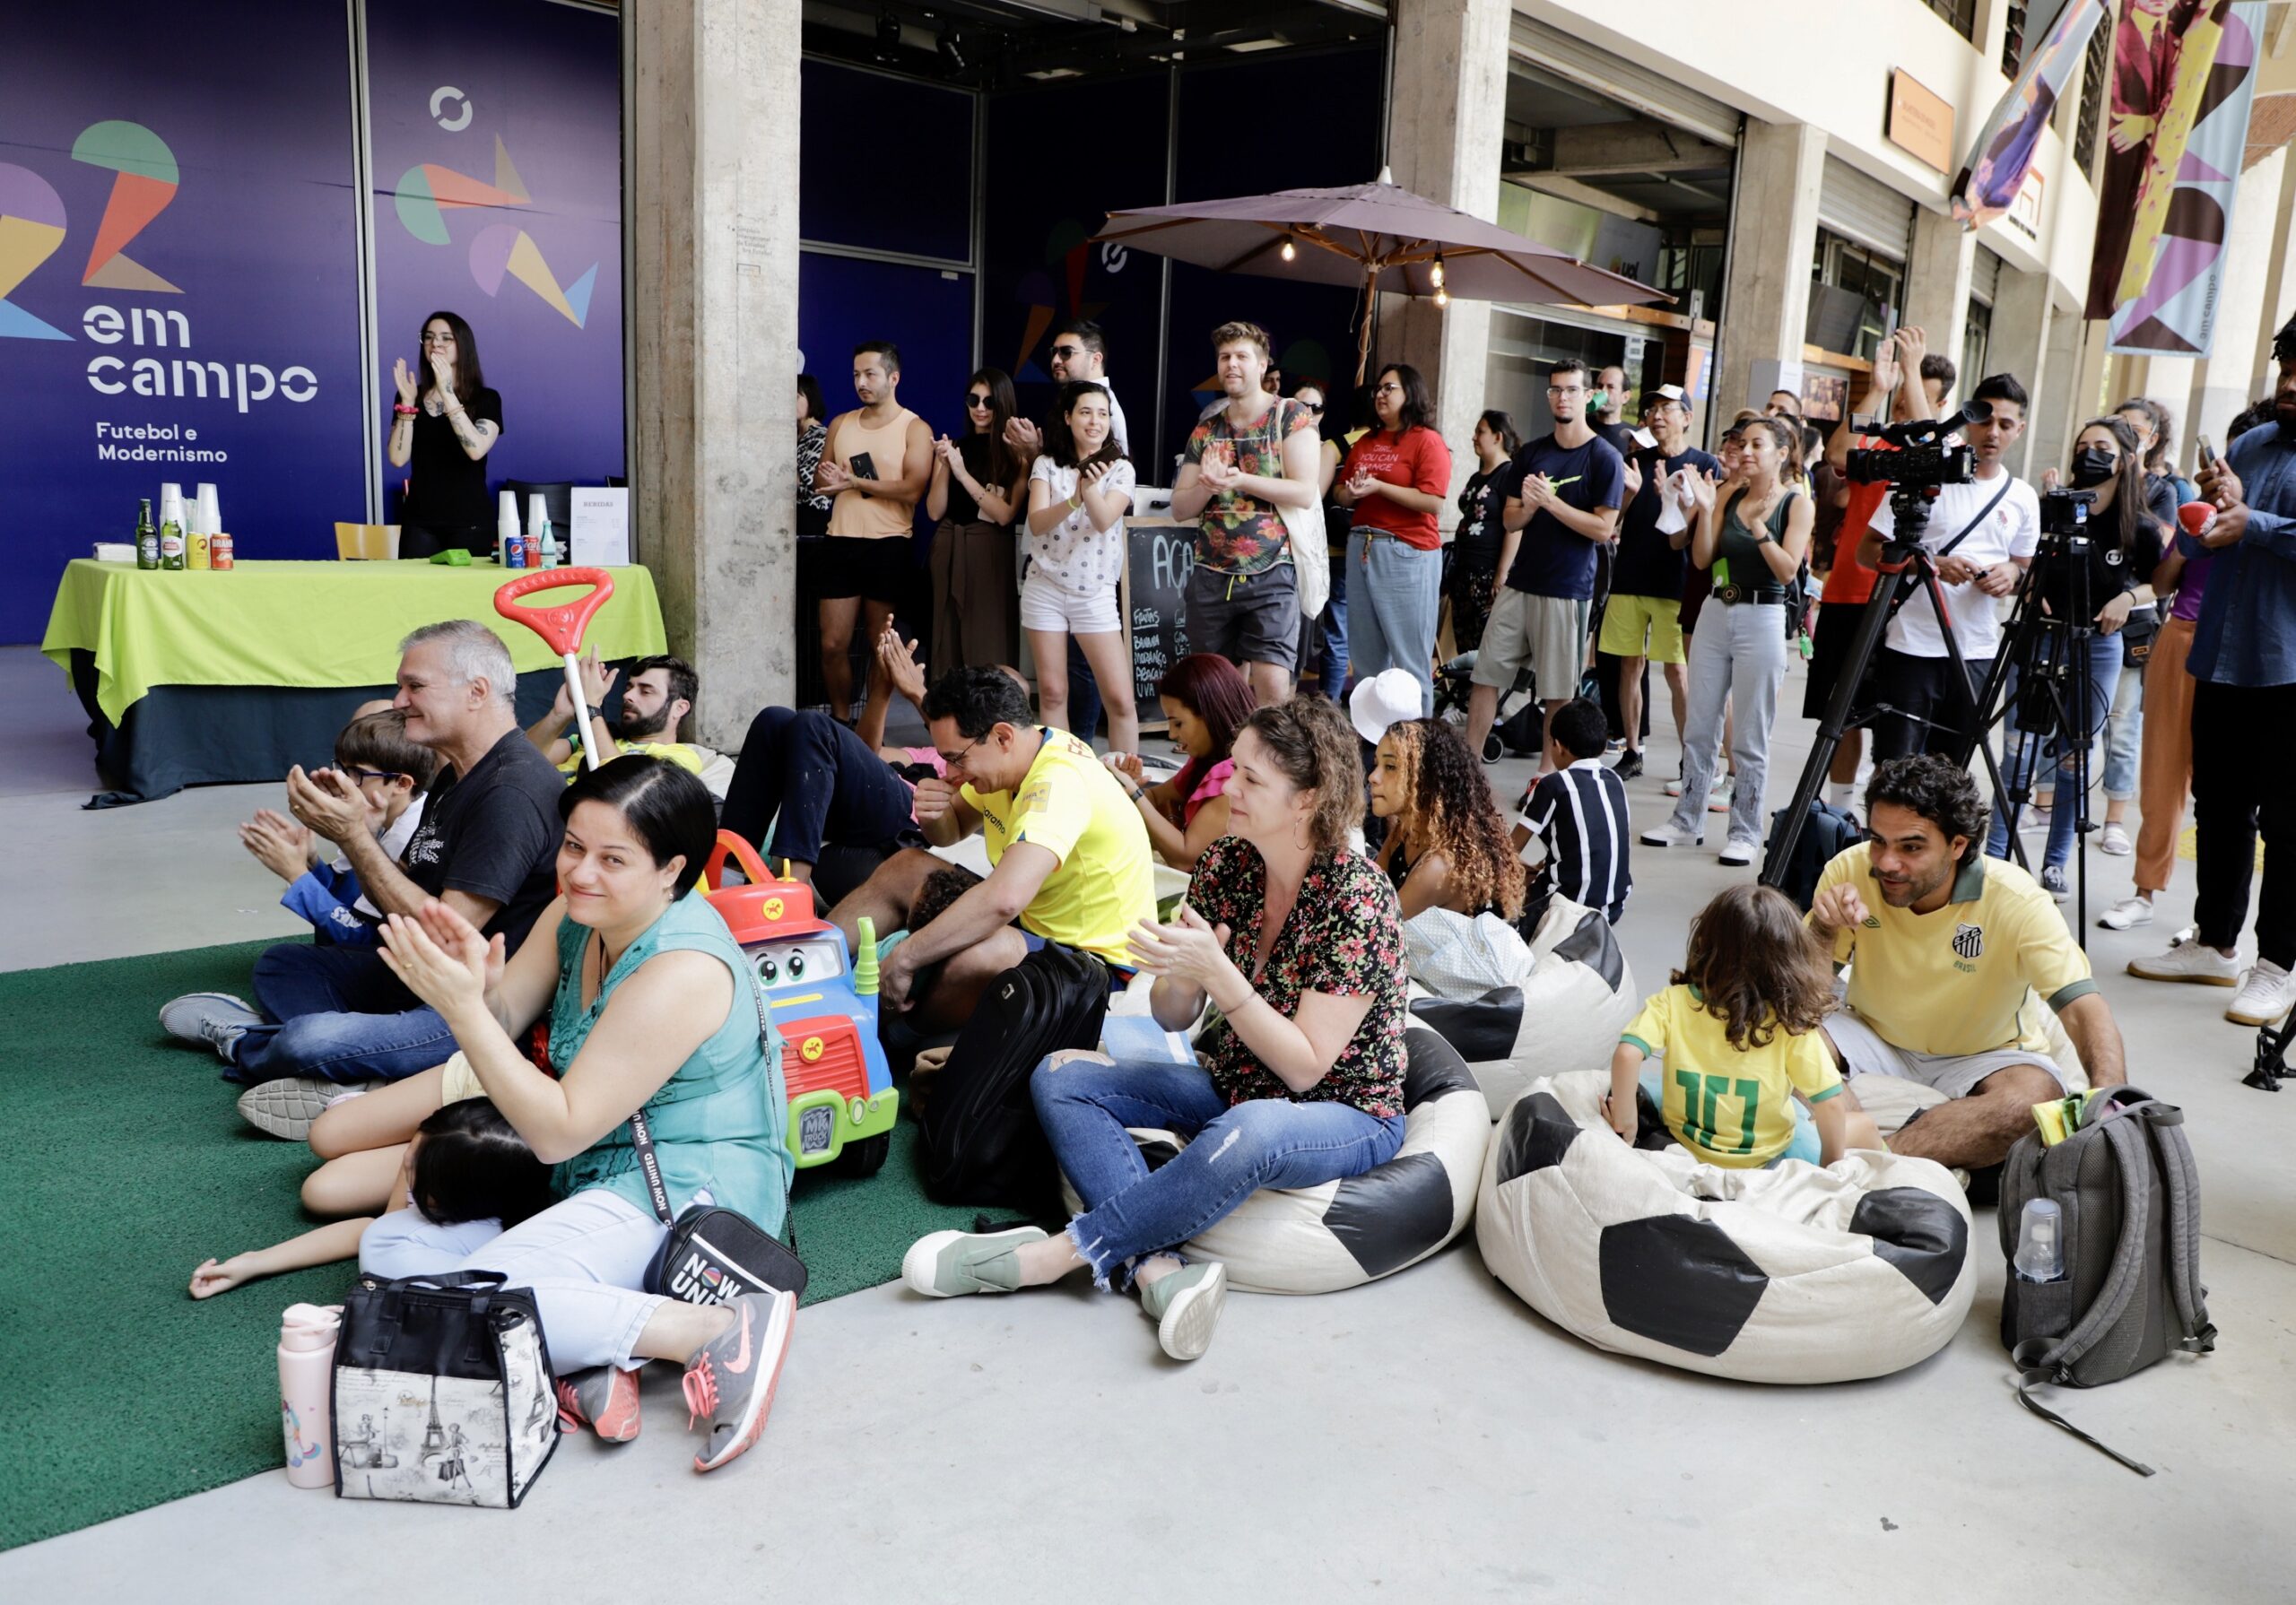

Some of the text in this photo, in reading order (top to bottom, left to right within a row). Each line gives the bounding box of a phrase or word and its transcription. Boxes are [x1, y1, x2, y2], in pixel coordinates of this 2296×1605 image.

[2204, 274, 2217, 317] campo
[83, 305, 191, 348] em
[87, 356, 318, 413] campo
[96, 422, 197, 440] Futebol e
[98, 444, 228, 463] Modernismo
[1378, 454, 1398, 462] CAN
[1134, 634, 1160, 649] BANANA
[1135, 667, 1165, 681] ABACAX
[1136, 682, 1155, 698] UVA
[1953, 960, 1977, 973] BRASIL
[634, 1122, 648, 1145] NOW
[804, 1131, 827, 1142] TRUCK
[644, 1152, 667, 1211] NOW UNITED
[683, 1253, 742, 1298] NOW
